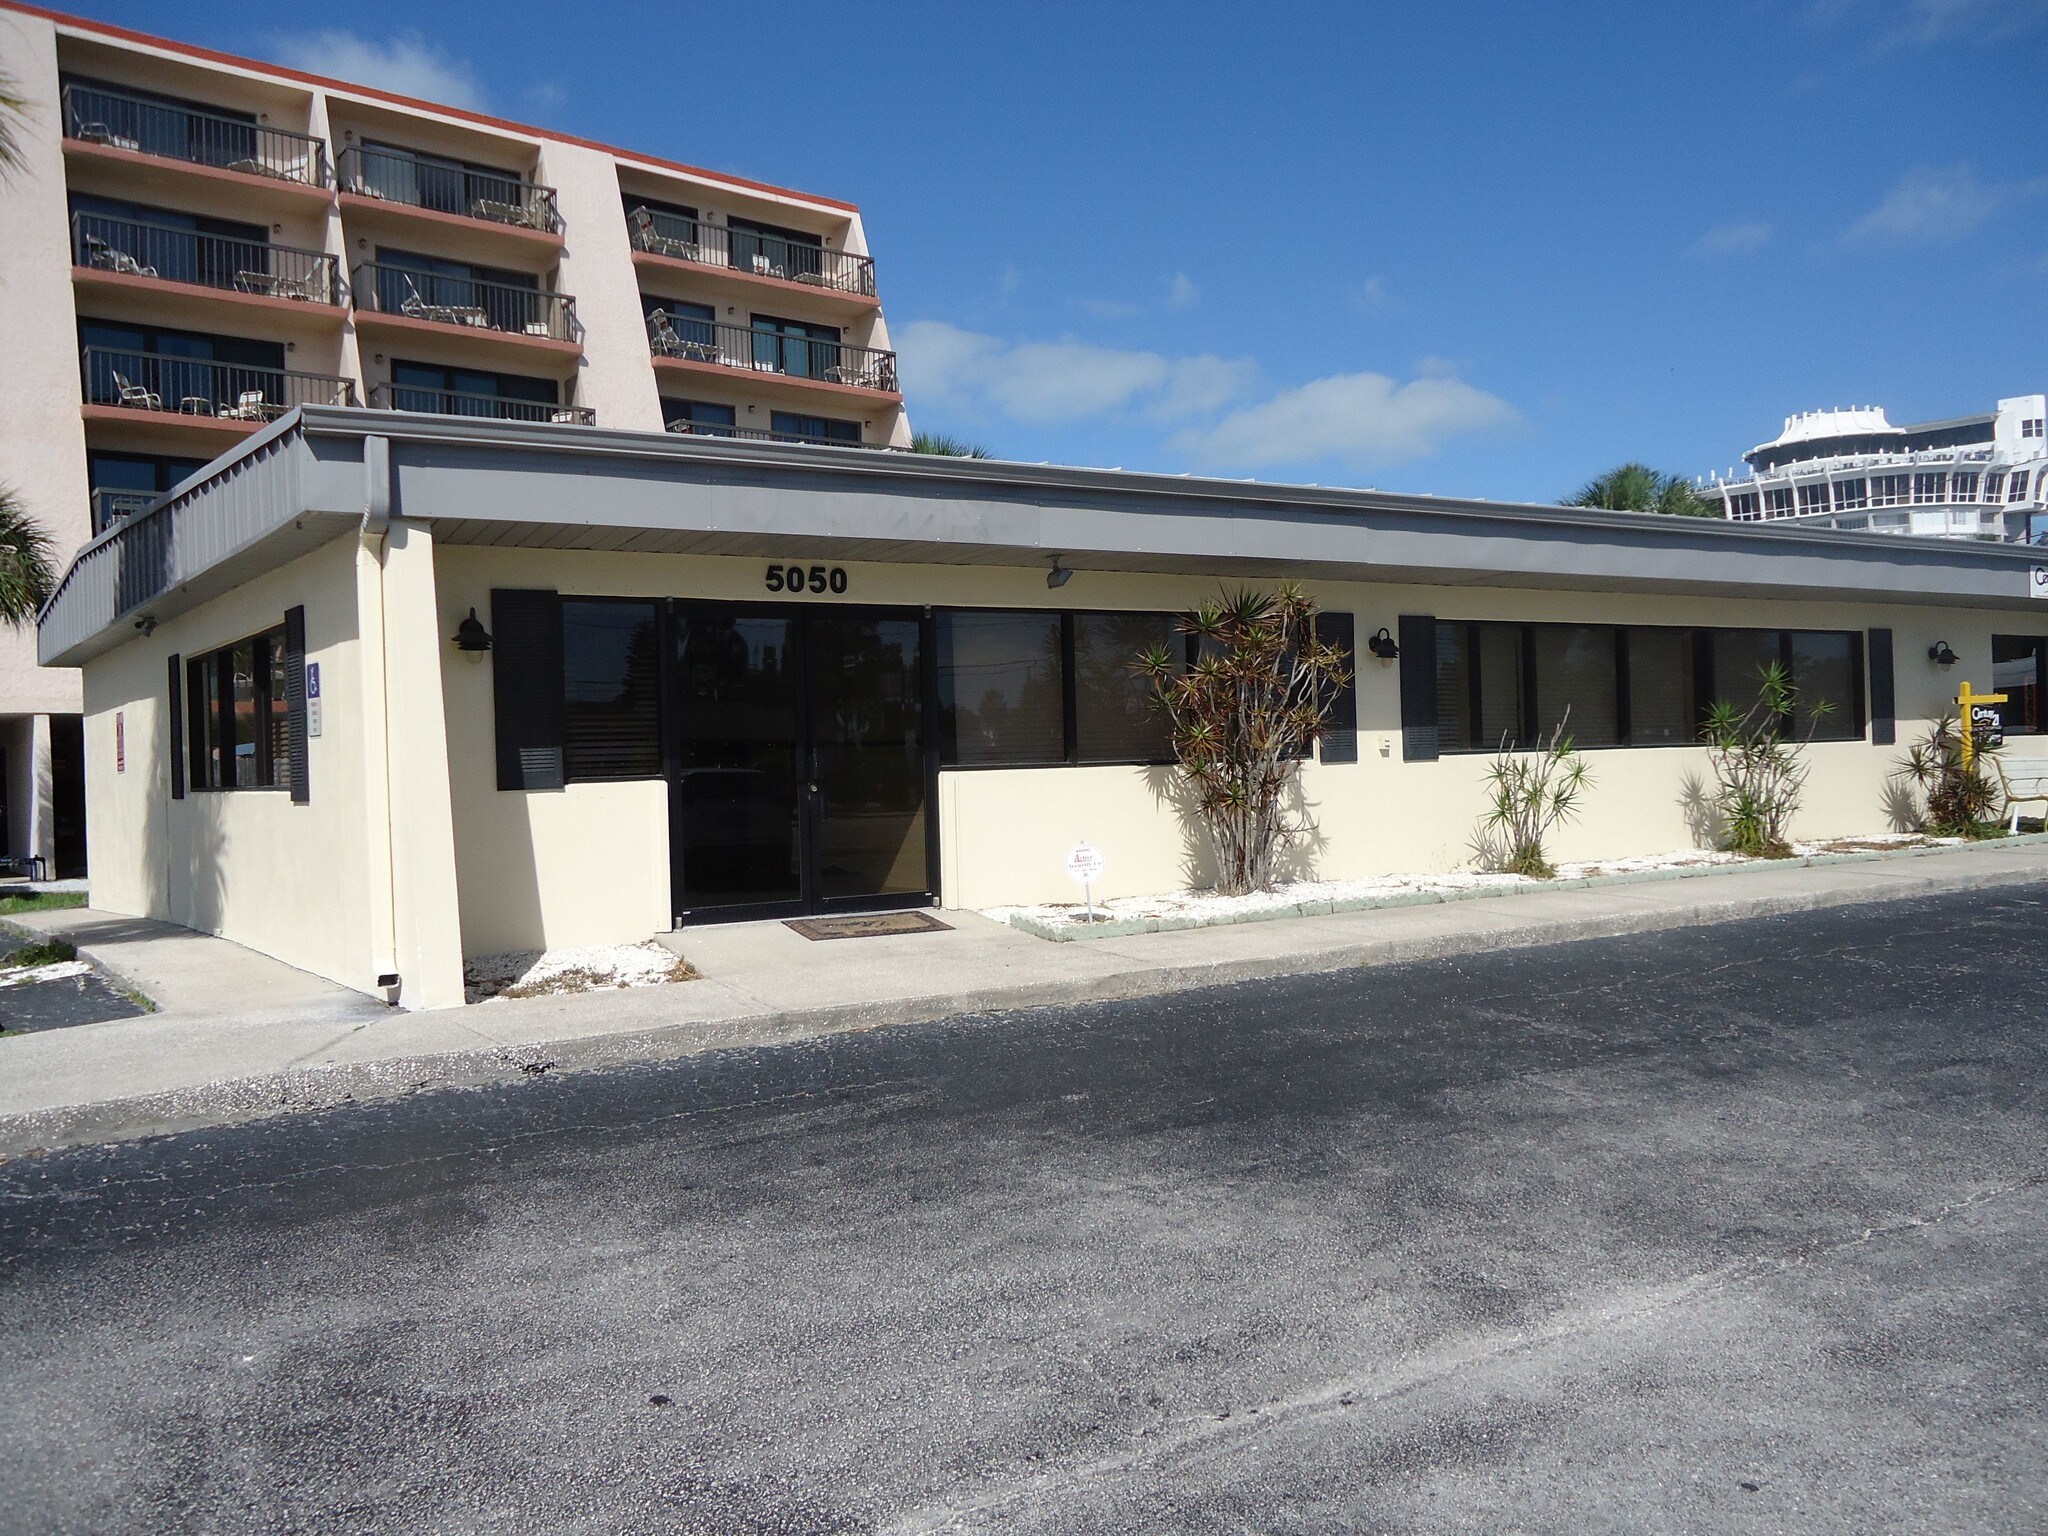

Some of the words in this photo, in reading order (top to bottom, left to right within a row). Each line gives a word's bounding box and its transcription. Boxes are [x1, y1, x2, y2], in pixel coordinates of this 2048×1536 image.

[765, 565, 847, 594] 5050
[2035, 567, 2048, 585] Ce
[1972, 707, 1994, 720] Century
